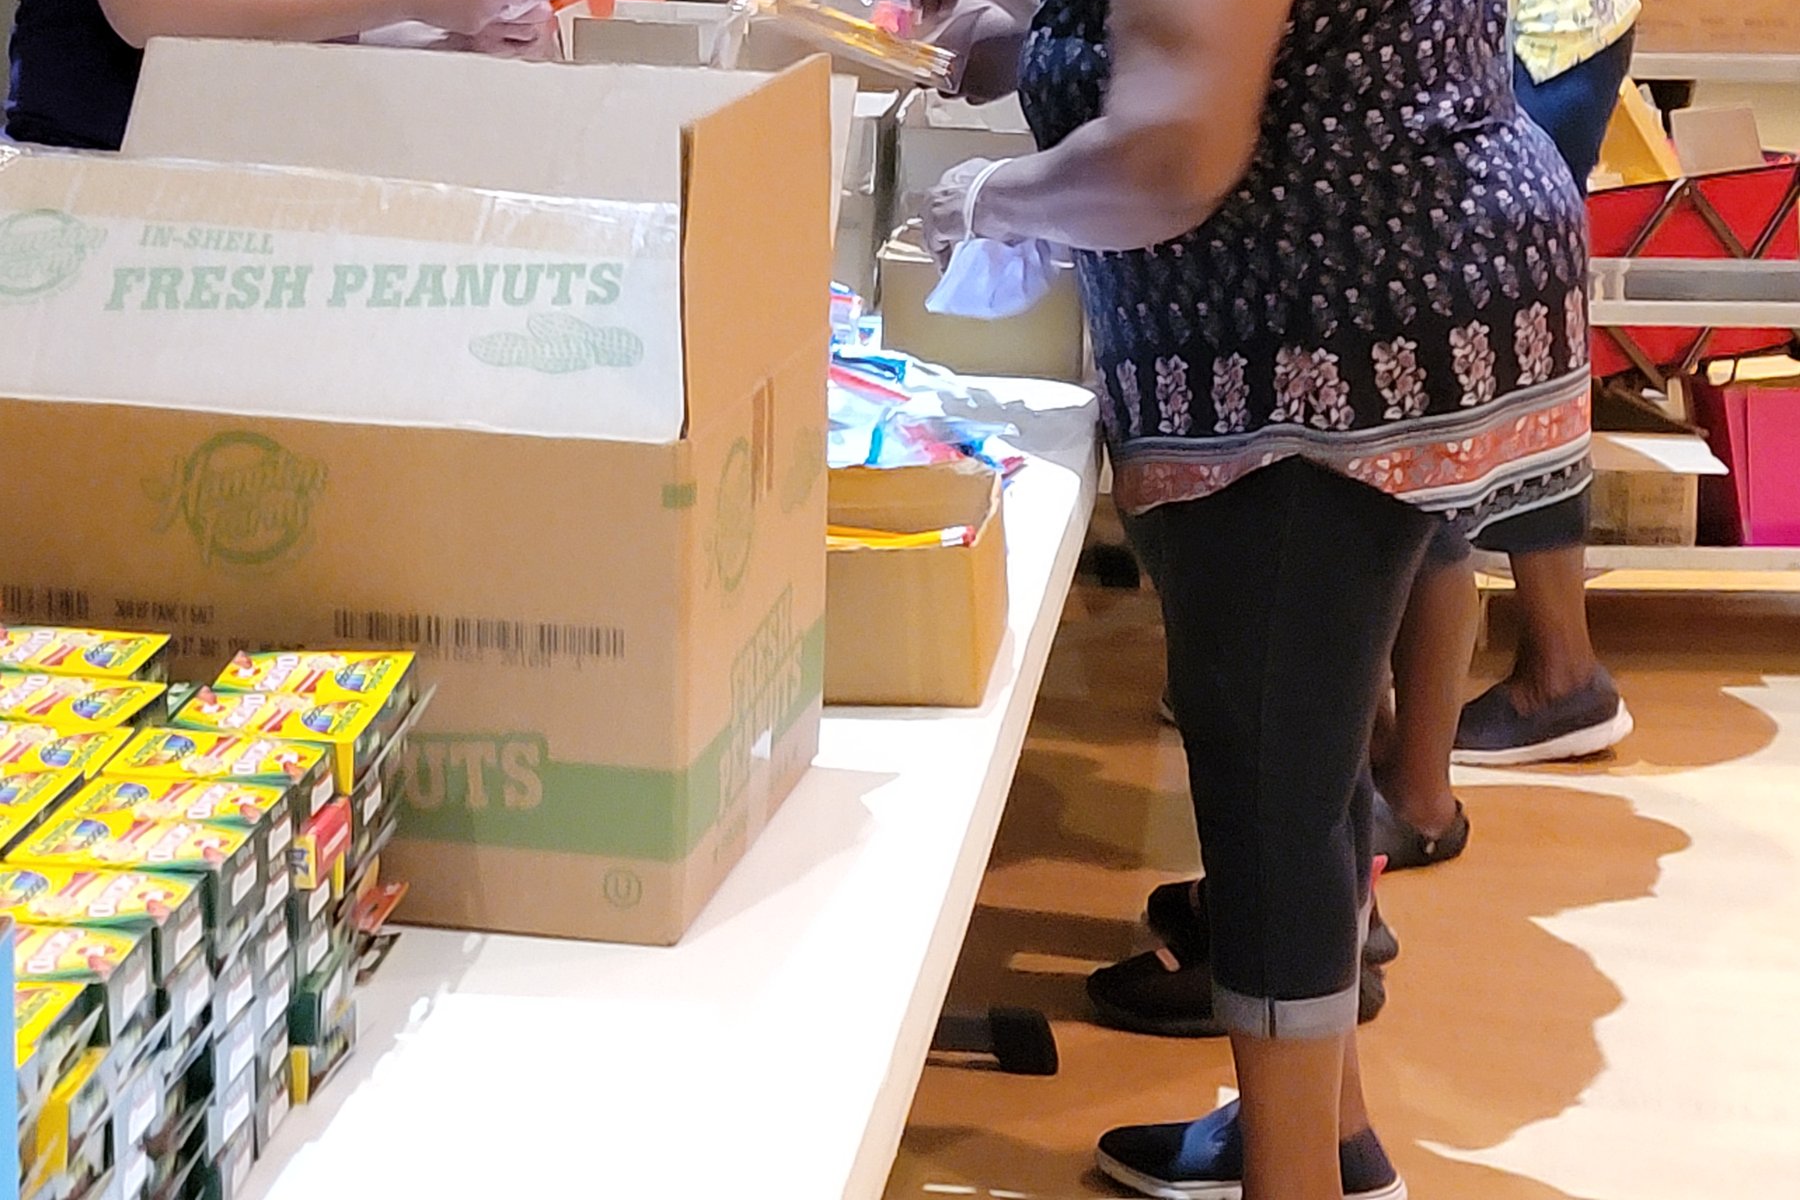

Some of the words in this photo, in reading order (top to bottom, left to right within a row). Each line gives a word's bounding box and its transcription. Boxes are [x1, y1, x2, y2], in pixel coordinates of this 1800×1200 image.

[139, 225, 274, 255] IN-SHELL
[103, 265, 313, 311] FRESH
[327, 263, 623, 308] PEANUTS
[386, 740, 543, 809] UTS
